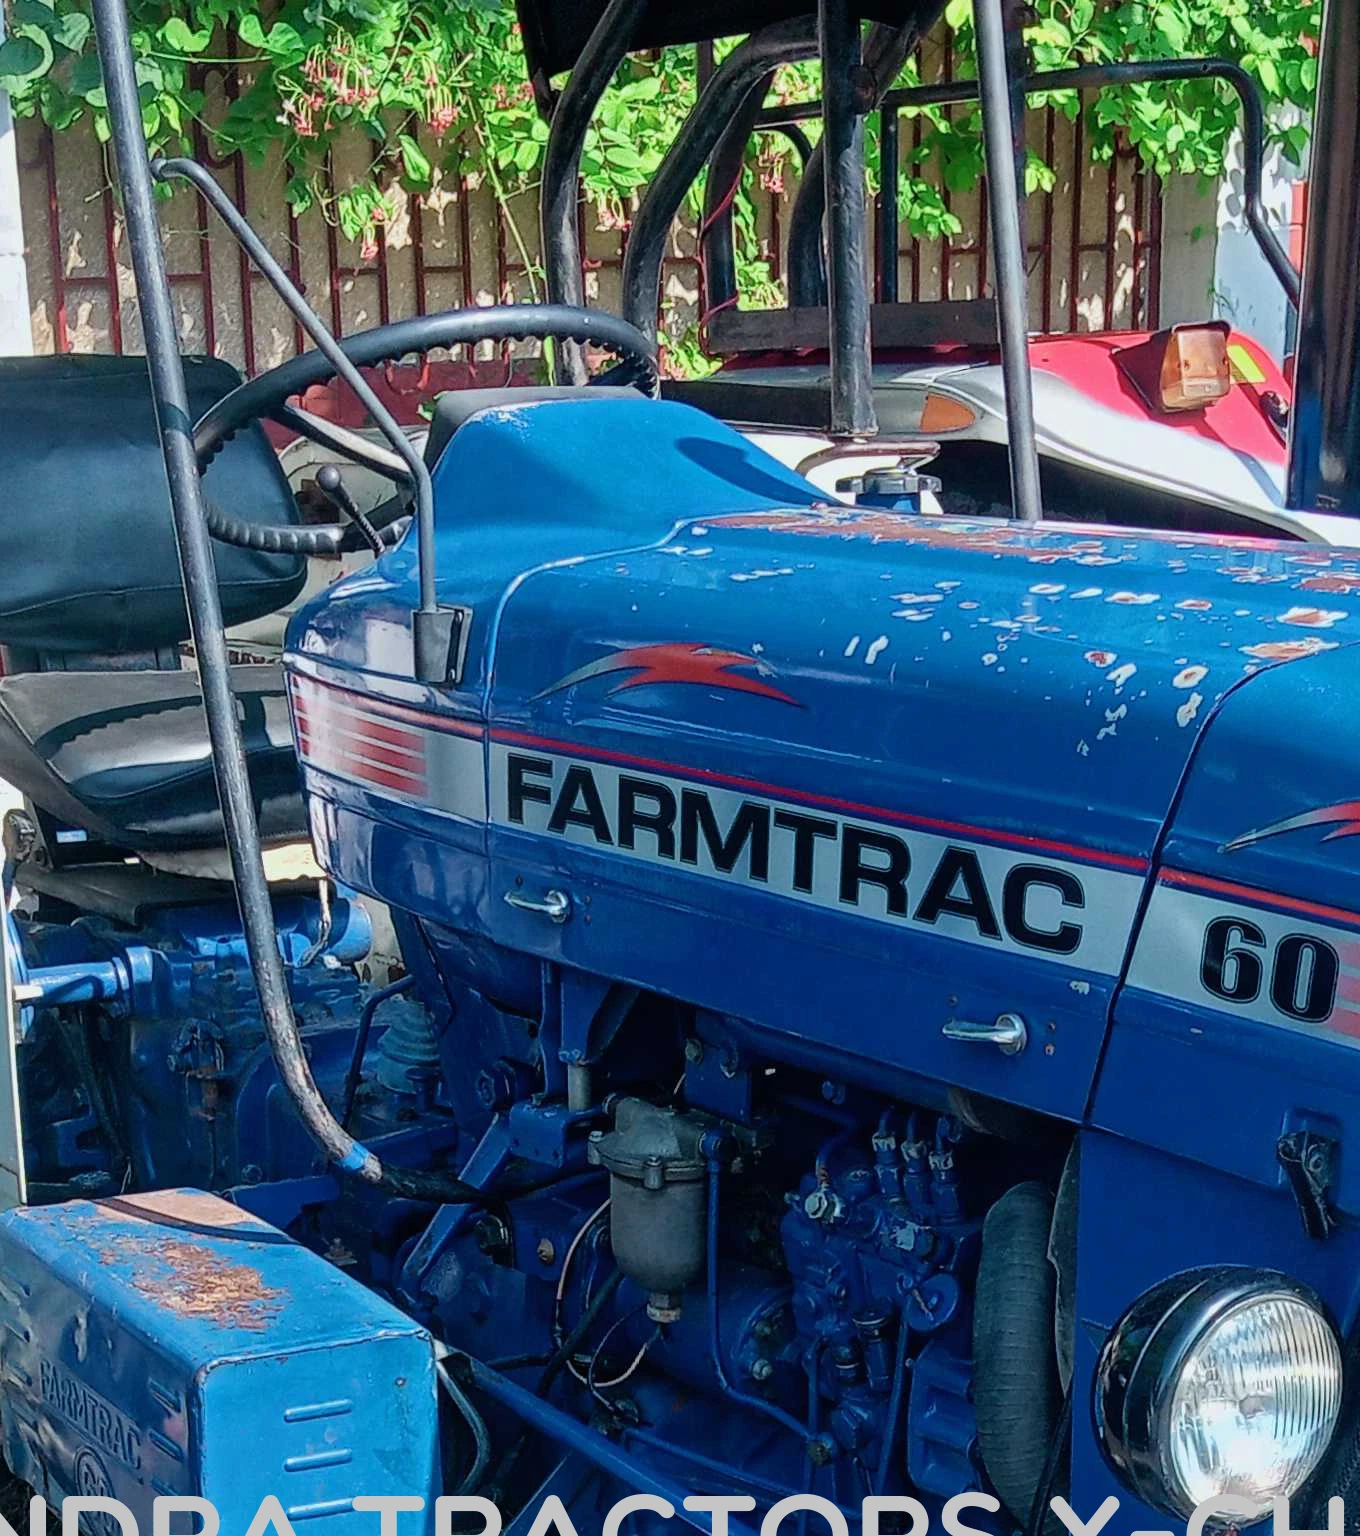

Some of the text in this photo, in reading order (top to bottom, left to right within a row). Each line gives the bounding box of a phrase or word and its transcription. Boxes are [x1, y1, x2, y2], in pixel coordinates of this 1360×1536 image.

[506, 753, 1085, 955] FARMTRAC
[1200, 914, 1340, 1024] 60
[40, 1359, 141, 1470] FARMTRAC
